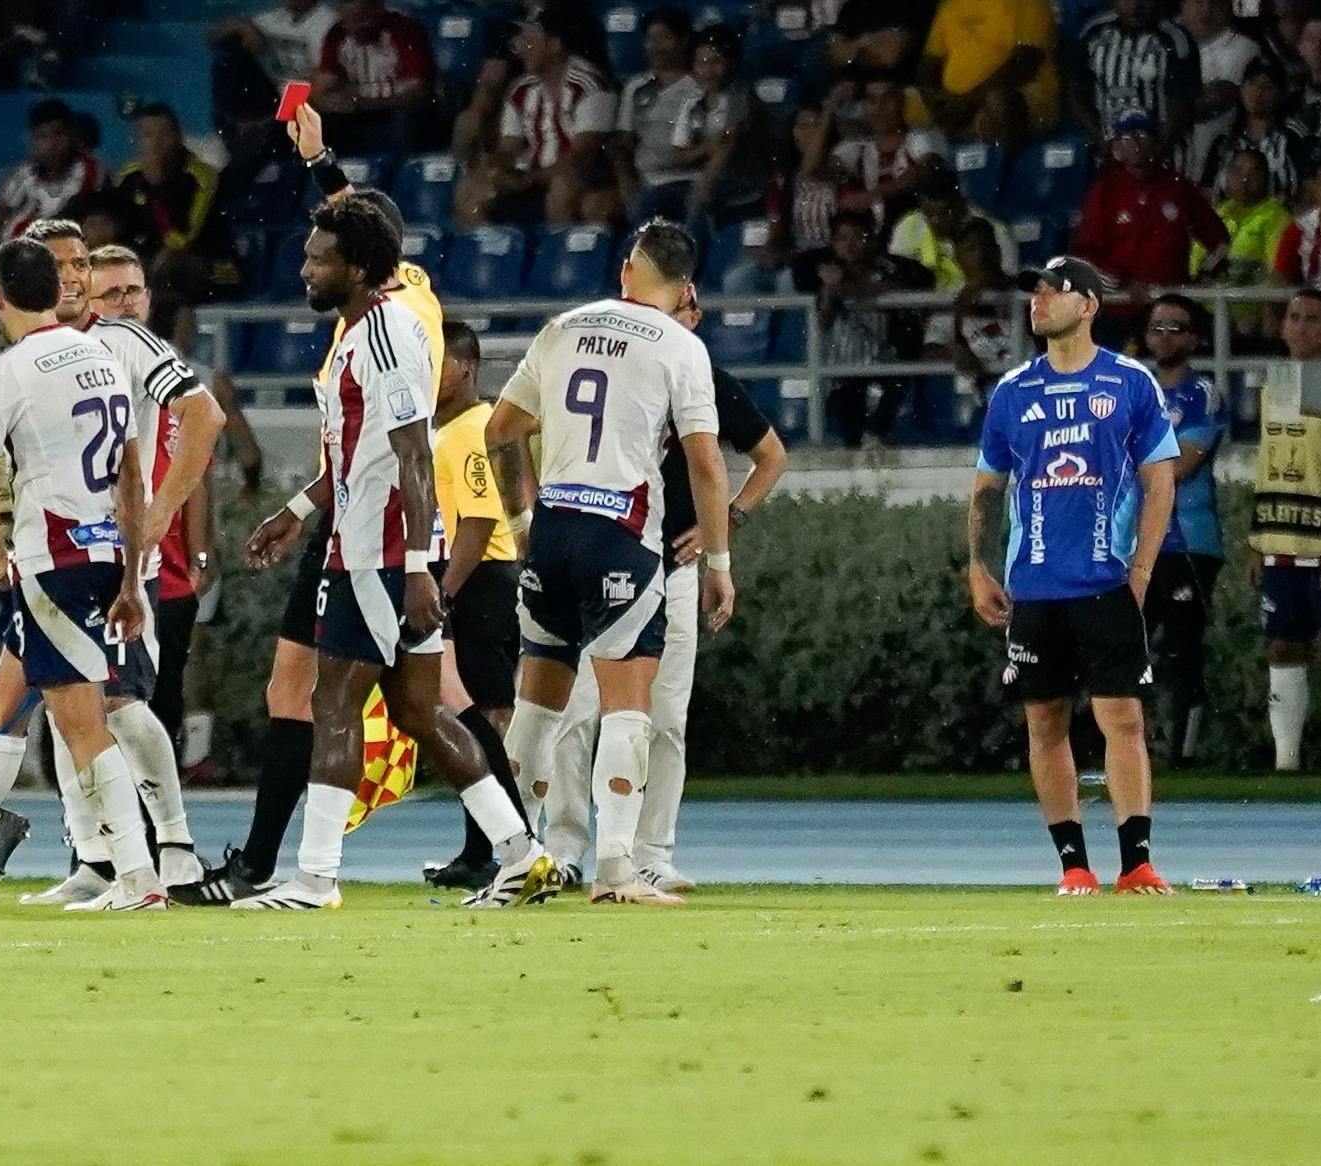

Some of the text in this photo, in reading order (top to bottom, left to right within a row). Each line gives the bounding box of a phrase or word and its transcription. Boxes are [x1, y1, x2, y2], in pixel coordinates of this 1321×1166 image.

[576, 336, 629, 358] PAIVA
[75, 367, 116, 390] CELIS
[564, 367, 609, 463] 9
[1055, 397, 1077, 420] UT
[71, 394, 130, 493] 28
[471, 451, 488, 499] Kalley
[316, 579, 330, 616] 6
